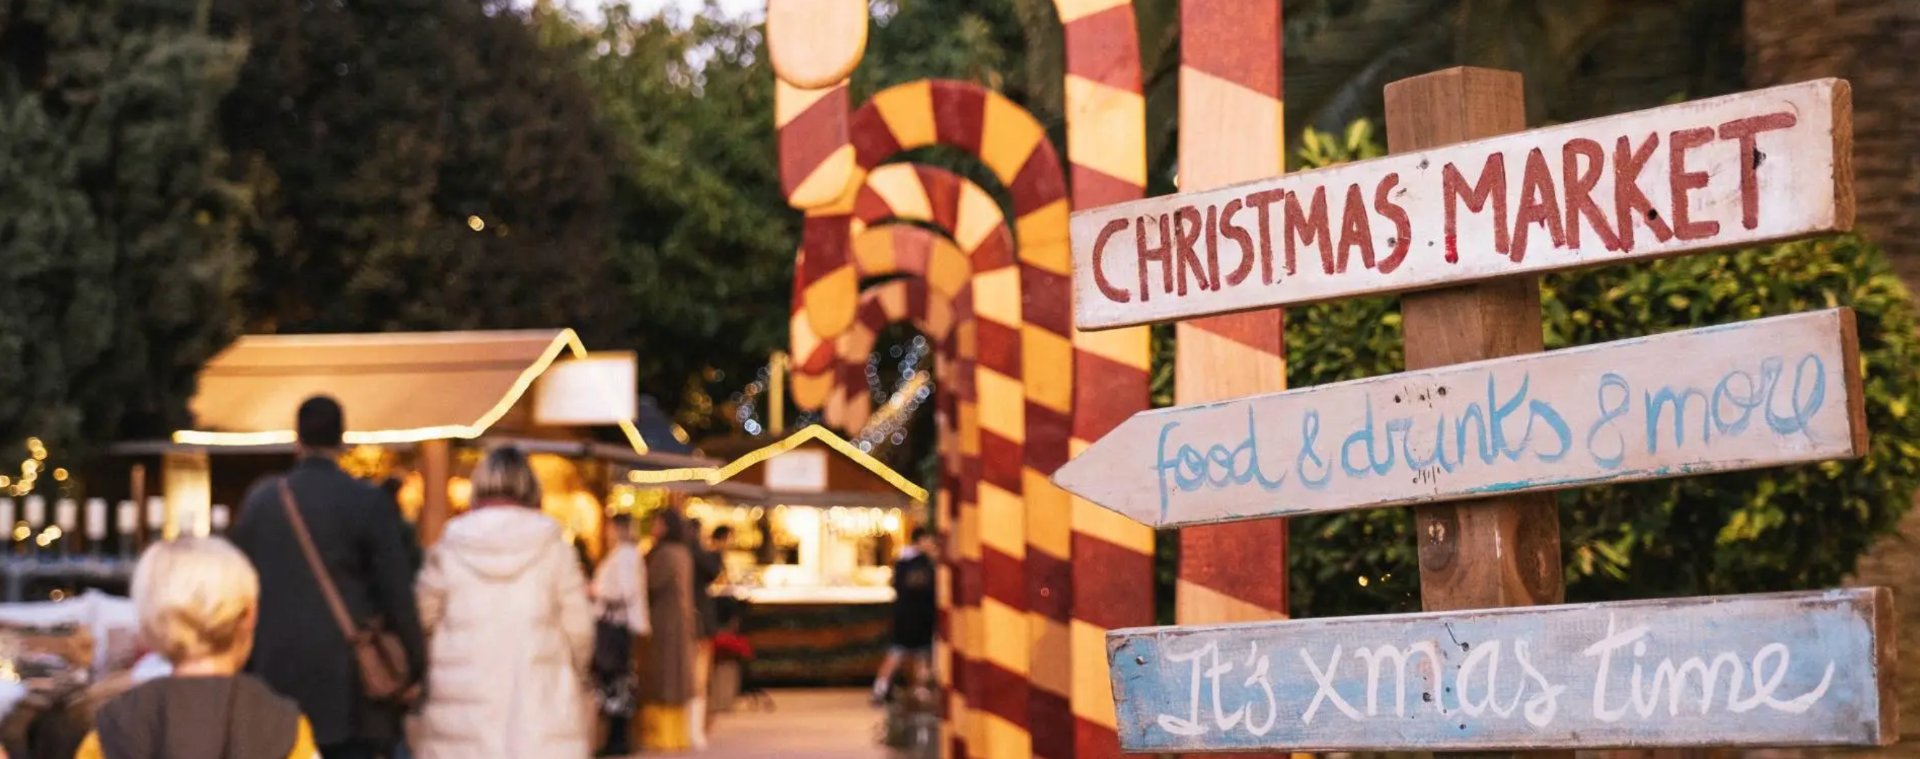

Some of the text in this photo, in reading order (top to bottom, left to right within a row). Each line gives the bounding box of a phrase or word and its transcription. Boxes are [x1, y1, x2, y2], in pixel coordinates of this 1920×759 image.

[1092, 111, 1797, 303] CHRISTMAS MARKET
[1152, 403, 1287, 520] food
[1297, 408, 1333, 490] &
[1341, 371, 1573, 478] drinks
[1644, 352, 1827, 455] more
[1157, 612, 1835, 737] It's xmas time
